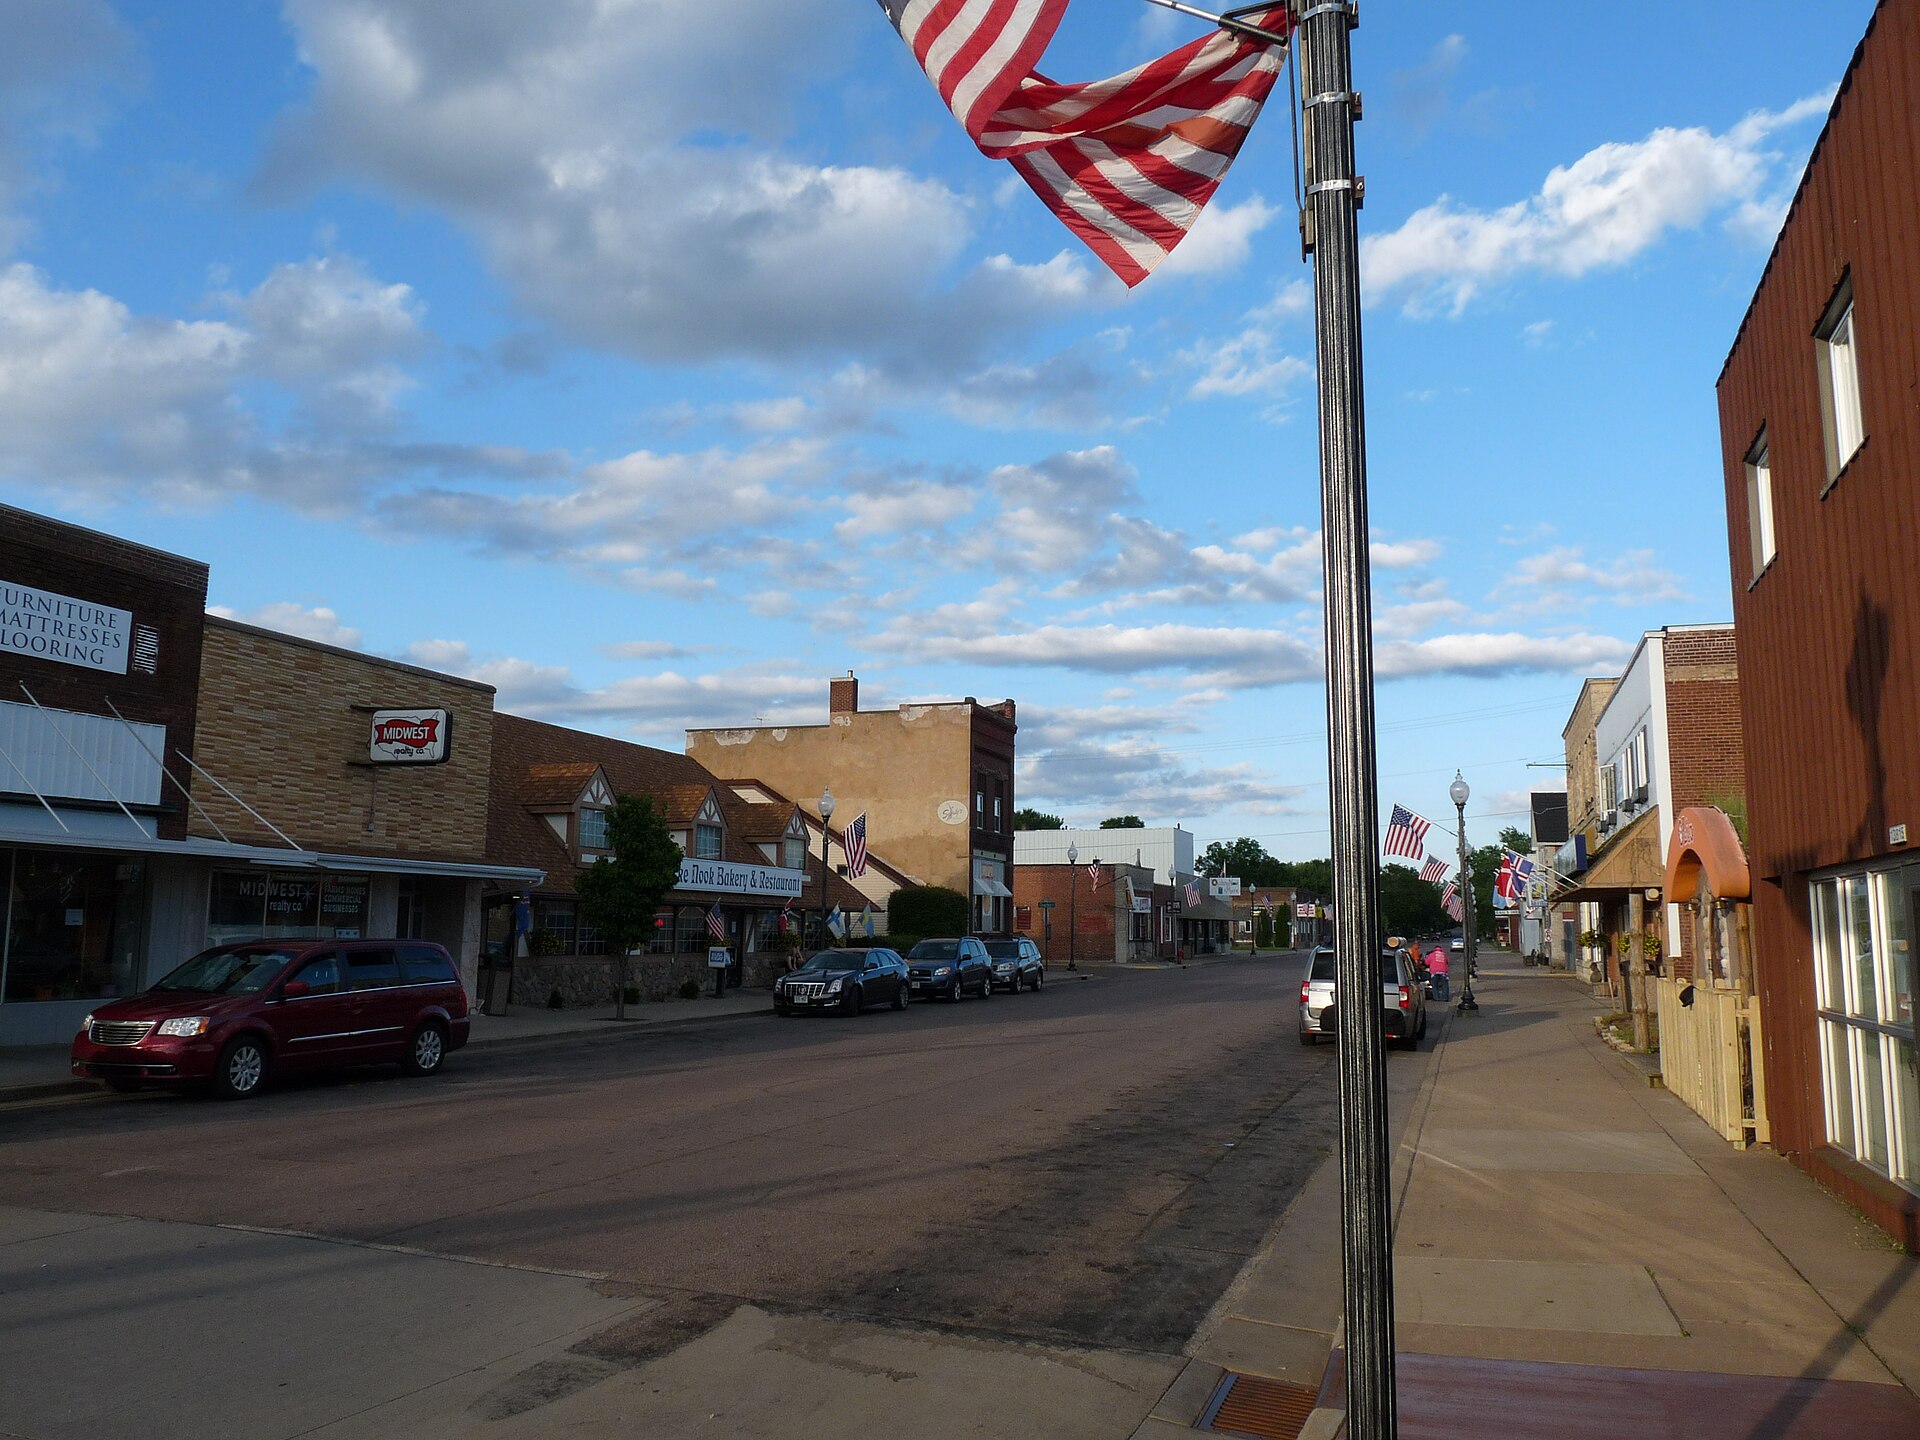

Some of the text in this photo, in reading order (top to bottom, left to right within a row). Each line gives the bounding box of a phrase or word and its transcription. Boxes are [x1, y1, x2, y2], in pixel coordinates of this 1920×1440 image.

[0, 587, 118, 629] URNITURE
[0, 629, 104, 665] LOORING
[383, 727, 429, 739] MIDWEST
[394, 746, 414, 757] realty
[691, 864, 715, 885] Nook
[717, 867, 748, 892] Bakery
[750, 870, 758, 889] &
[759, 871, 800, 892] Restaurant
[239, 881, 302, 897] MIDWEST
[269, 901, 303, 914] realty co.
